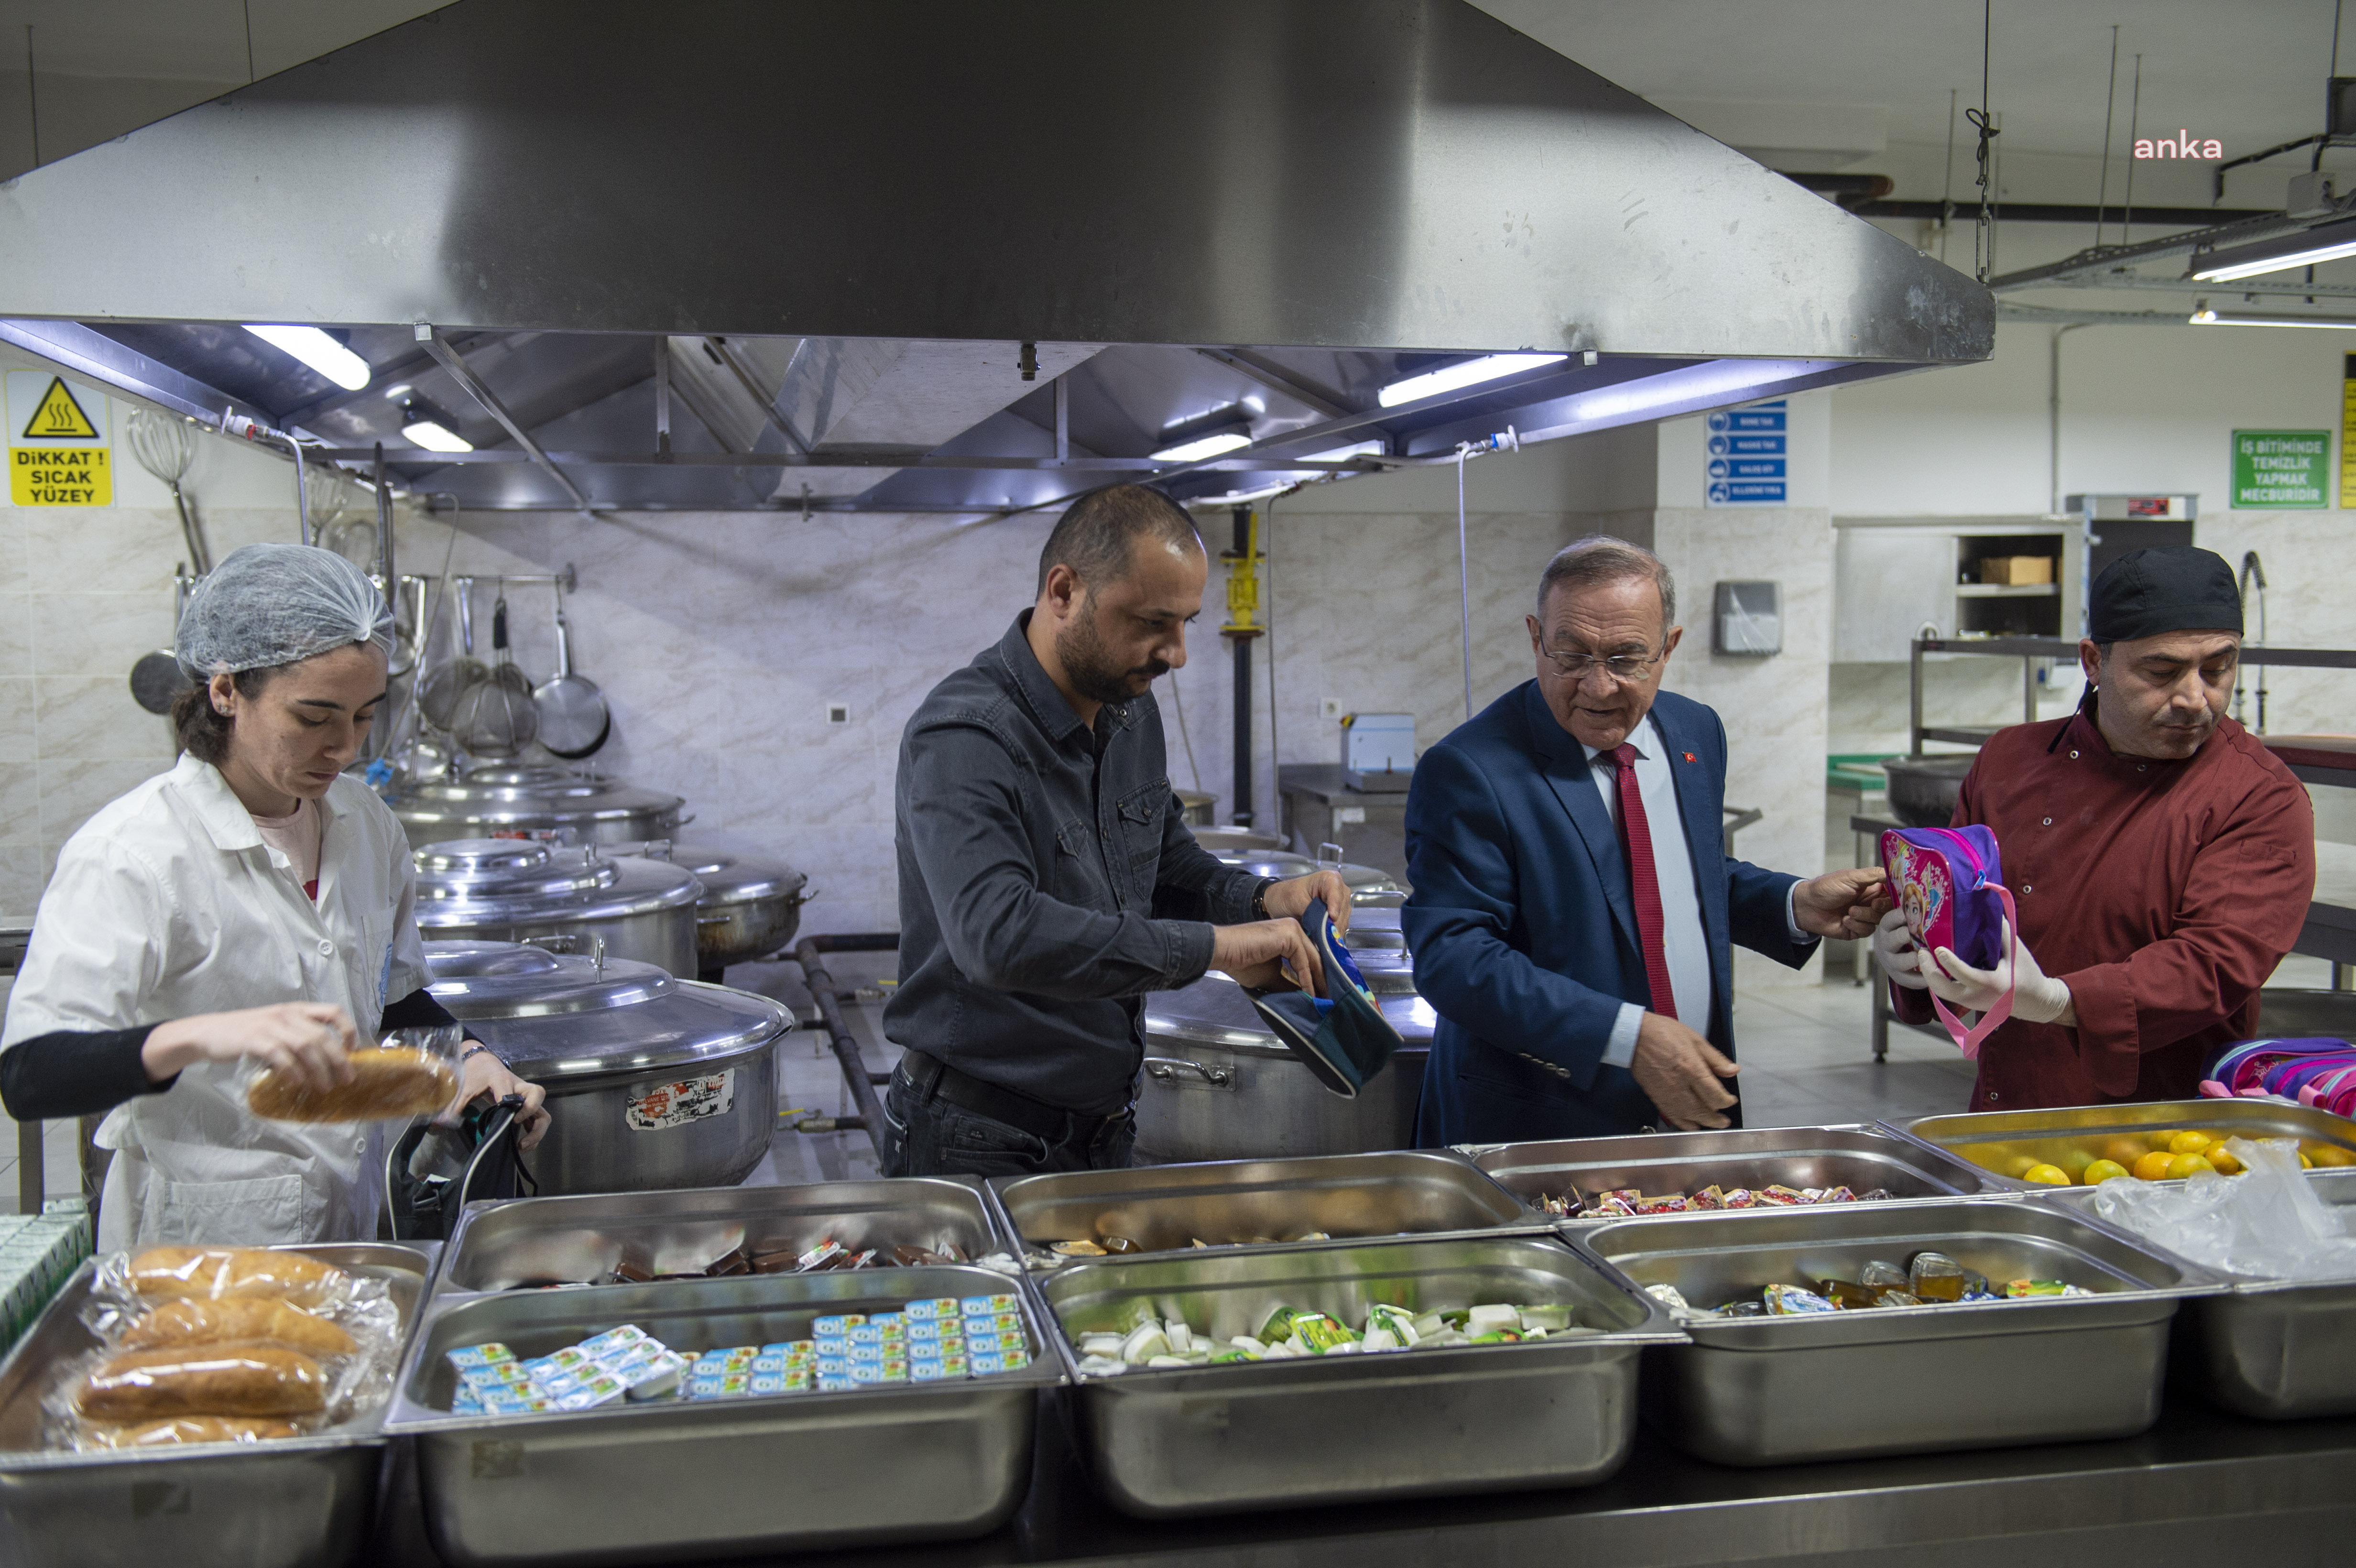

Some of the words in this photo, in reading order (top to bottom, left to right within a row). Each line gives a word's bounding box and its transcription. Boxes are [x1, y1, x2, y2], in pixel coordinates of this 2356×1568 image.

[2253, 455, 2311, 469] TEMİZLİK
[31, 471, 92, 484] SICAK
[2255, 472, 2308, 485] YAPMAK
[30, 486, 94, 502] YÜZEY
[2241, 486, 2320, 501] MECBURİDİR
